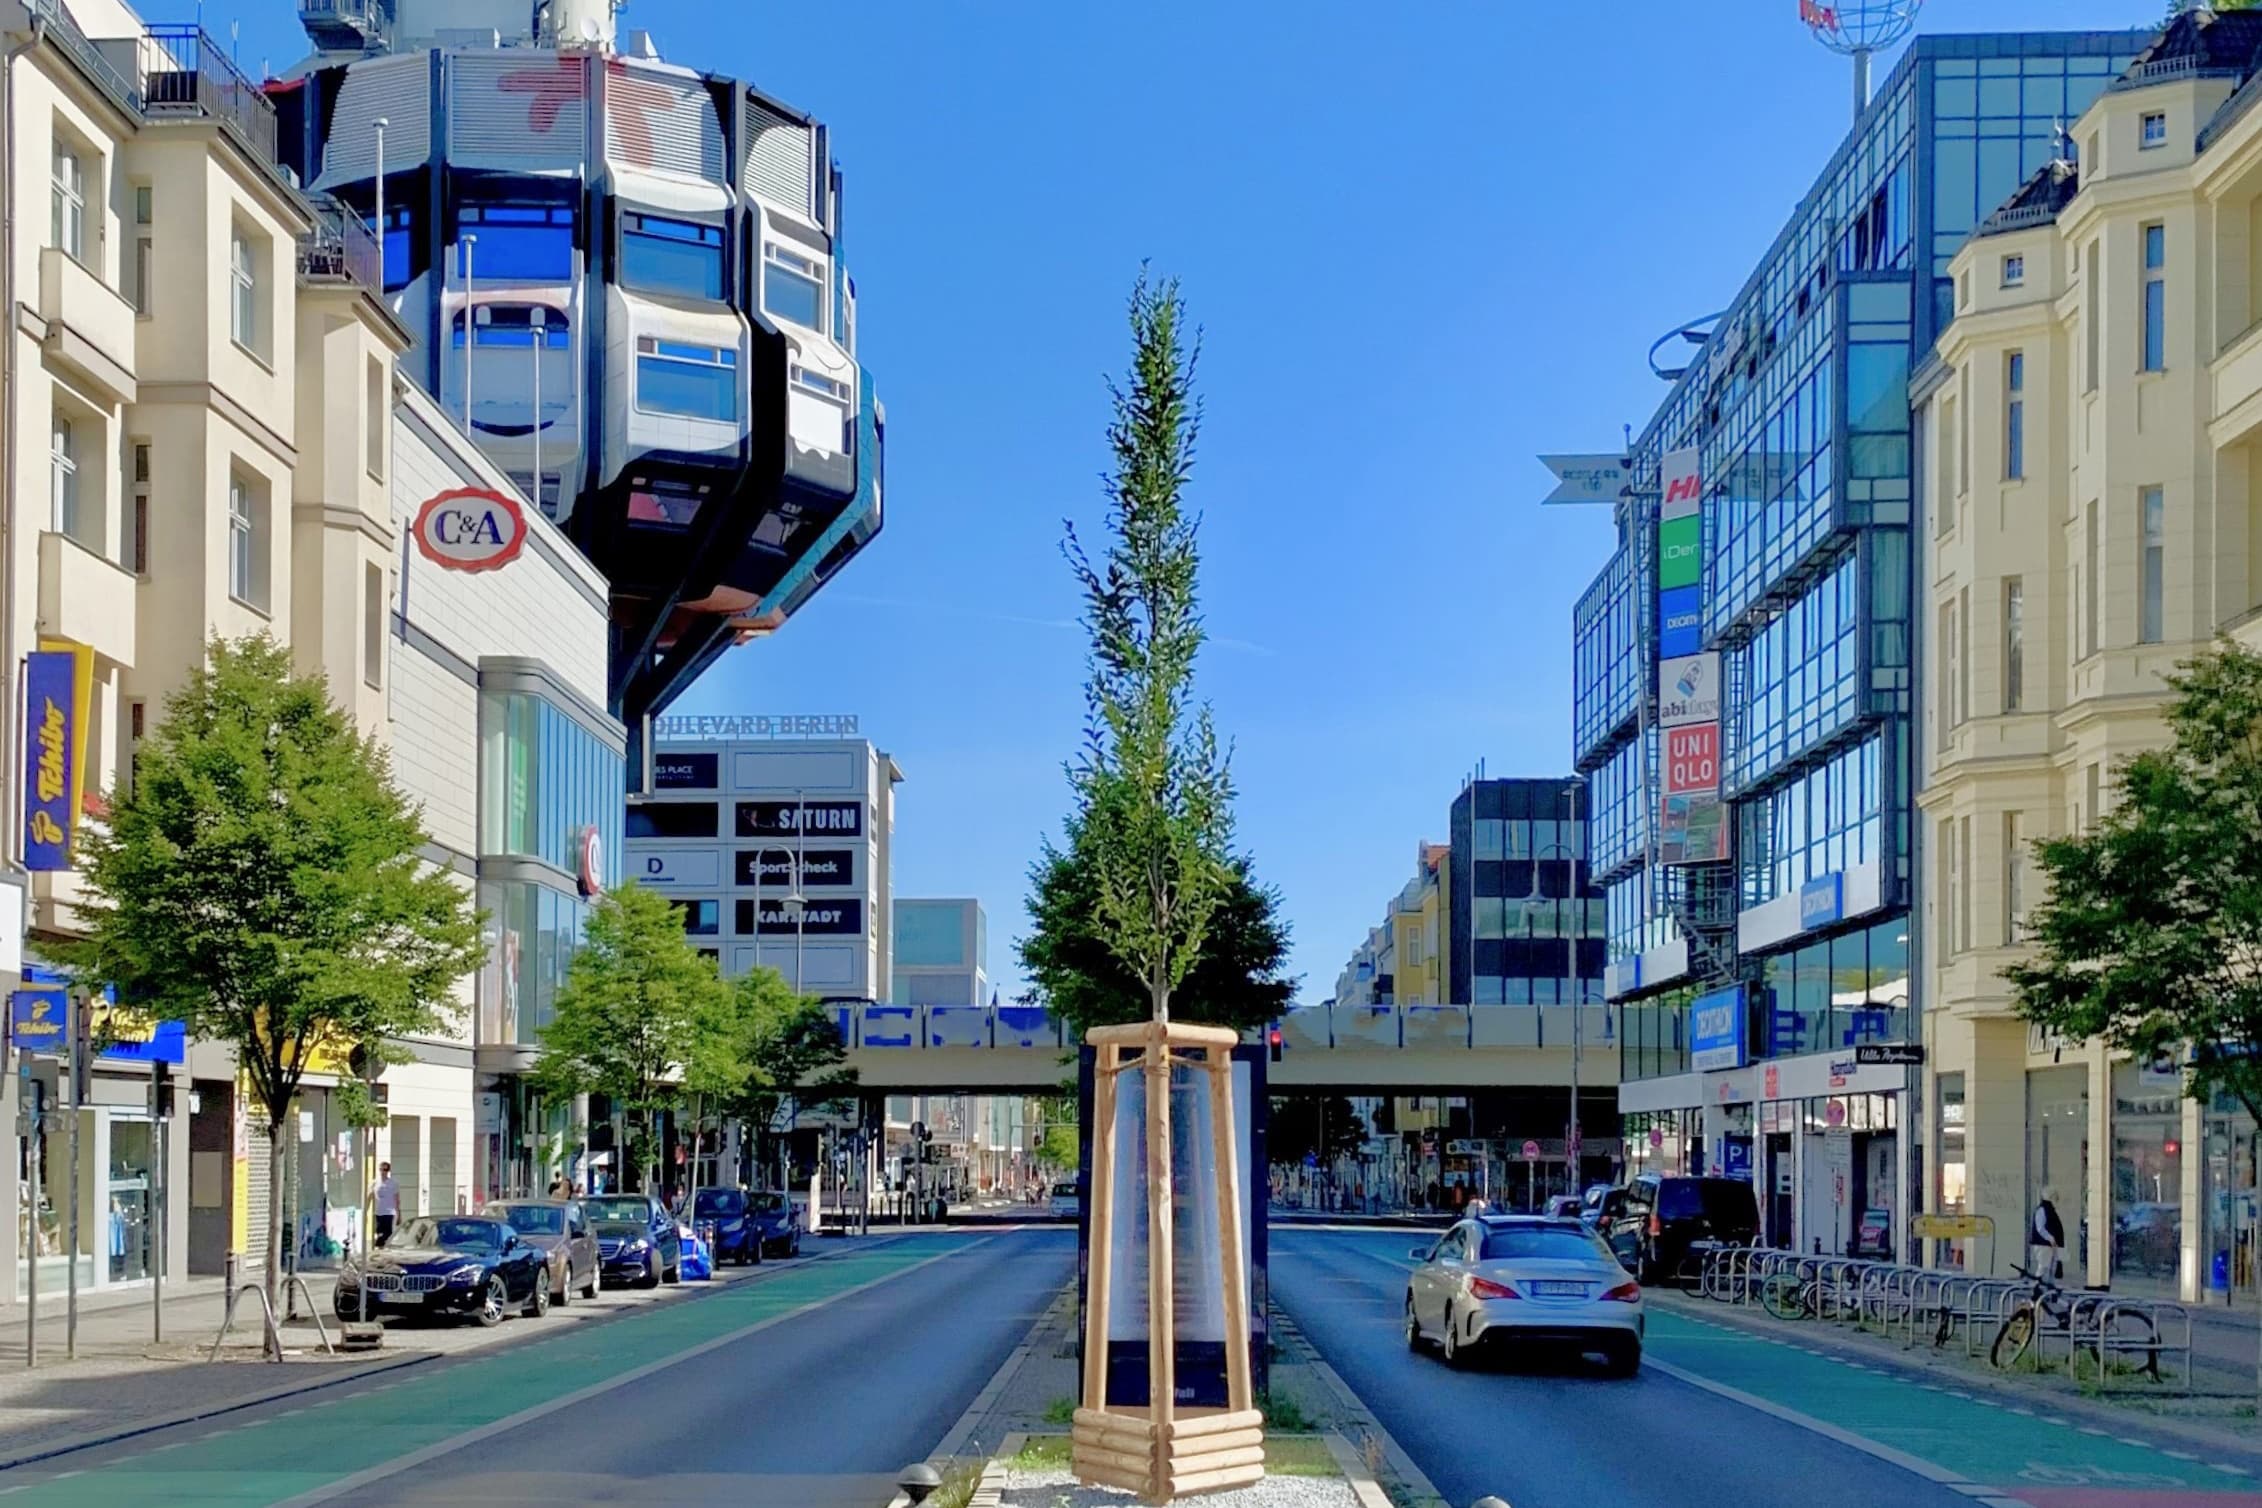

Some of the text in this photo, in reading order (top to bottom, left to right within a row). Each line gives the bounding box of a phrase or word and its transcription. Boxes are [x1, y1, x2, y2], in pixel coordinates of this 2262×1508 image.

[435, 510, 504, 544] C&A
[780, 715, 858, 734] BERLIN
[37, 696, 65, 802] Tchibo
[1673, 733, 1709, 758] UNI
[668, 765, 693, 774] PLACE
[1674, 759, 1712, 787] QLO
[778, 808, 855, 829] SATURN
